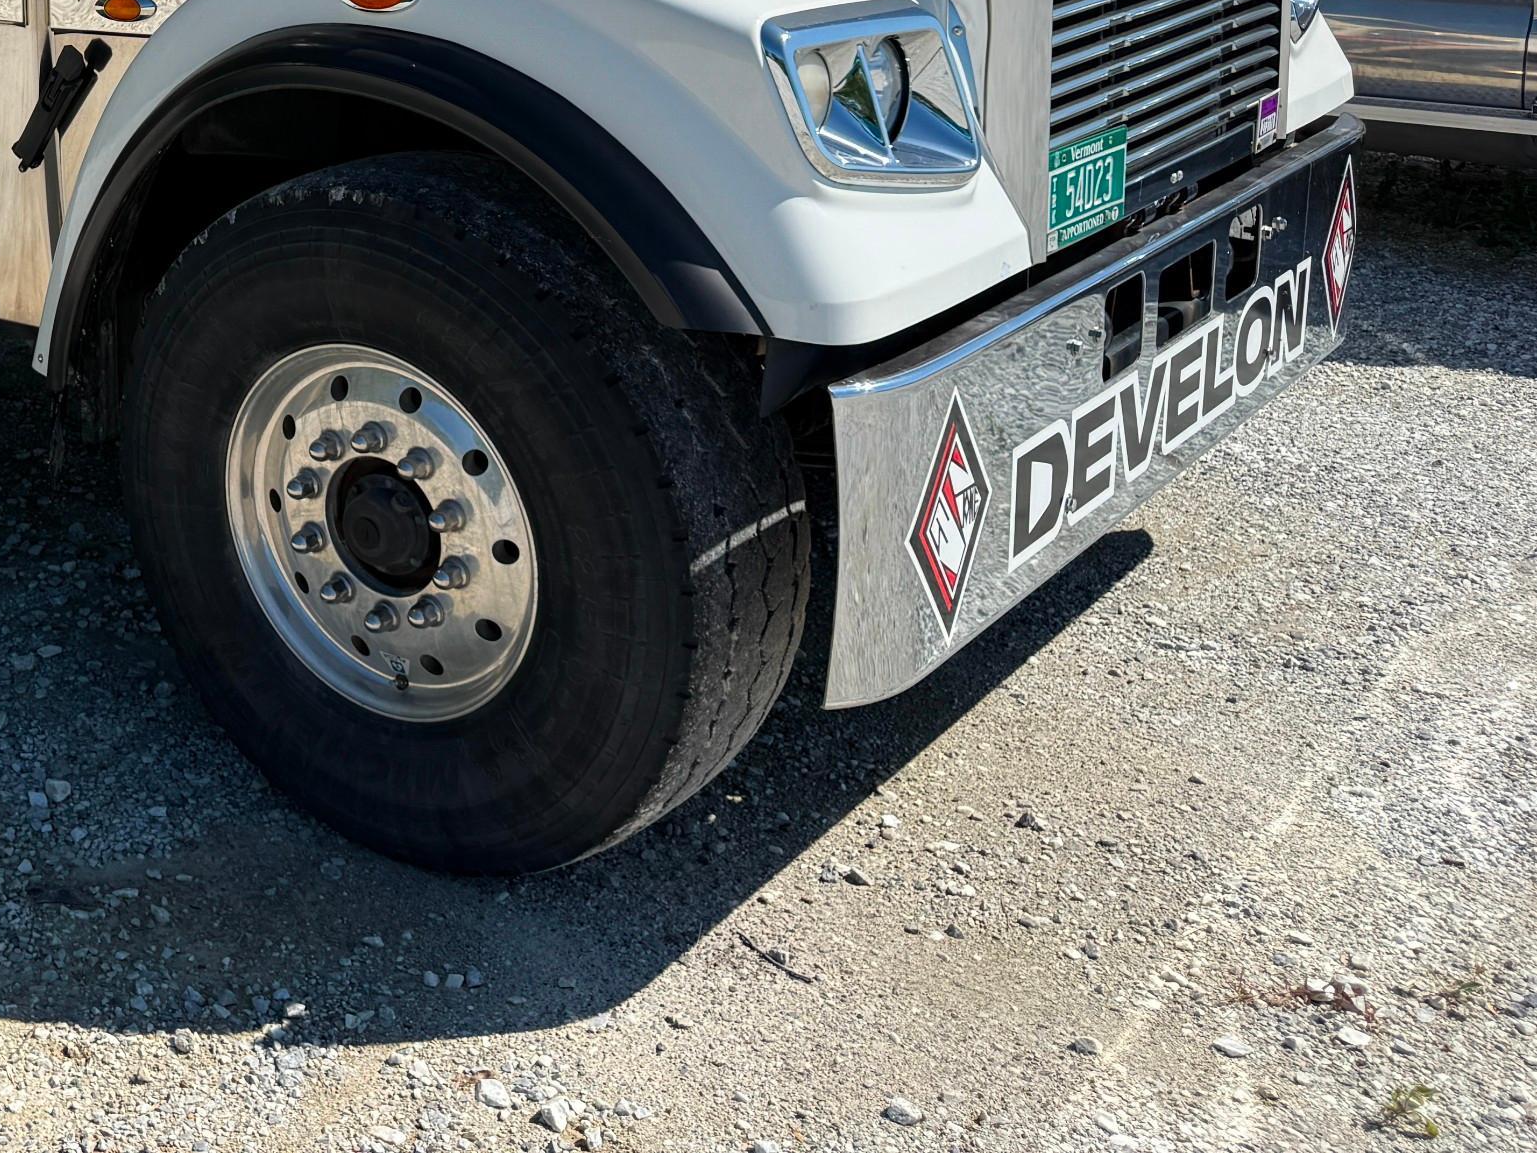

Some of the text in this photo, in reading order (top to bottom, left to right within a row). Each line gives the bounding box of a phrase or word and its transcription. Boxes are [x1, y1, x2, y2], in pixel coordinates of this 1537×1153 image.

[1071, 138, 1103, 161] Vermont
[1062, 212, 1105, 242] APPORTIONED
[1010, 258, 1313, 571] DEVELON
